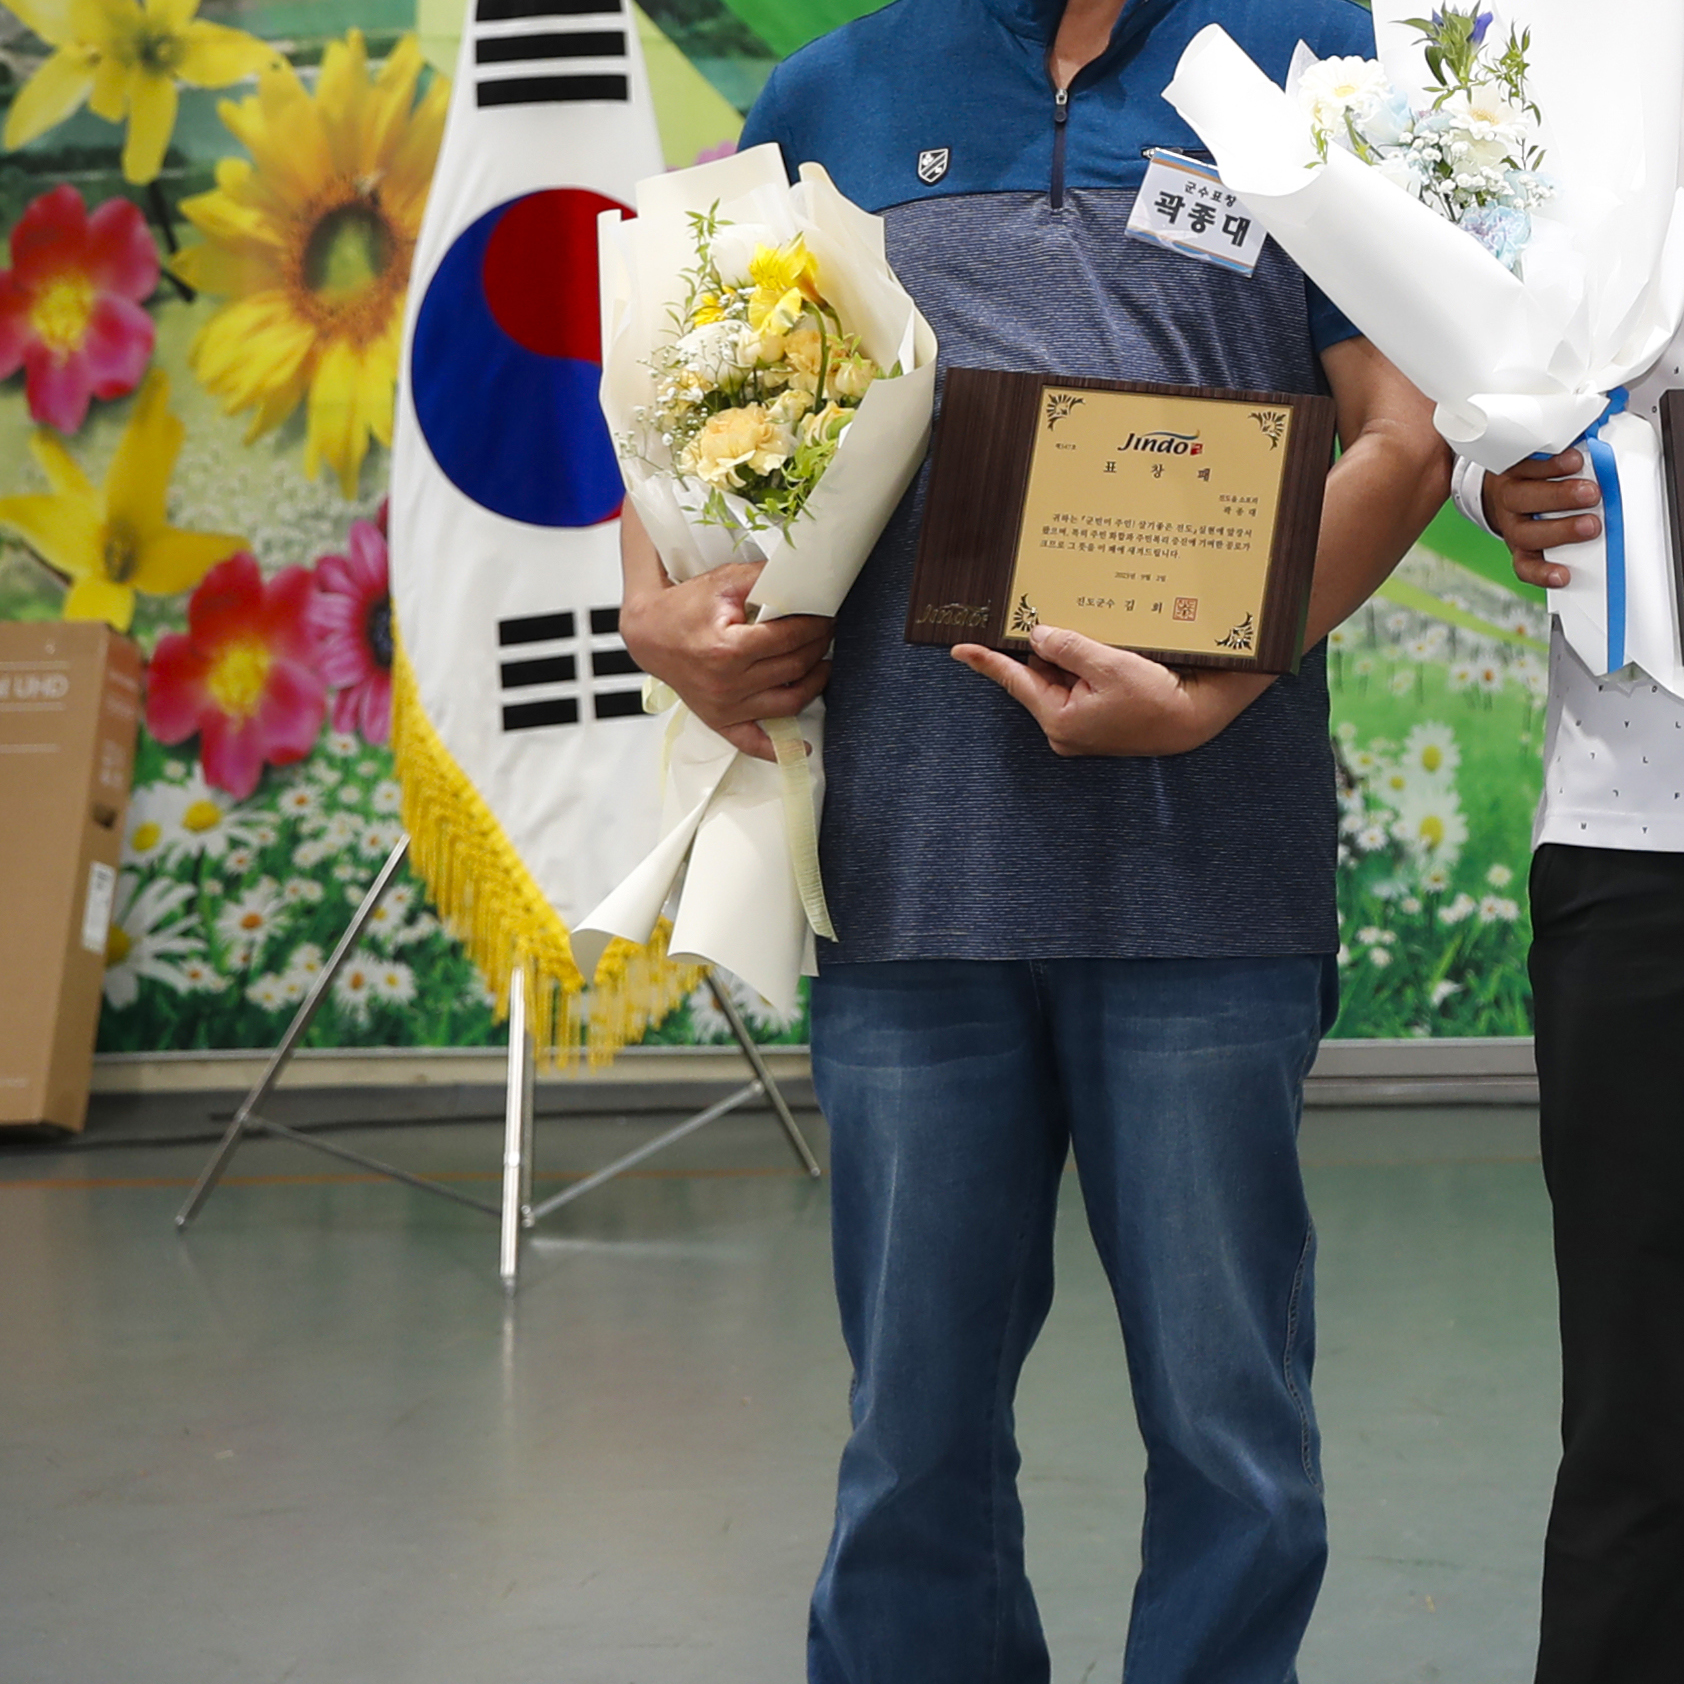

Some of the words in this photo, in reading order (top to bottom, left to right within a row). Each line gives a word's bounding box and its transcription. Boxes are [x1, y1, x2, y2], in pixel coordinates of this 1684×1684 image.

[1185, 181, 1237, 207] 군수표창
[1118, 433, 1188, 455] Jindo
[1103, 461, 1116, 473] 표
[1151, 464, 1164, 478] 창
[1198, 468, 1210, 481] 패
